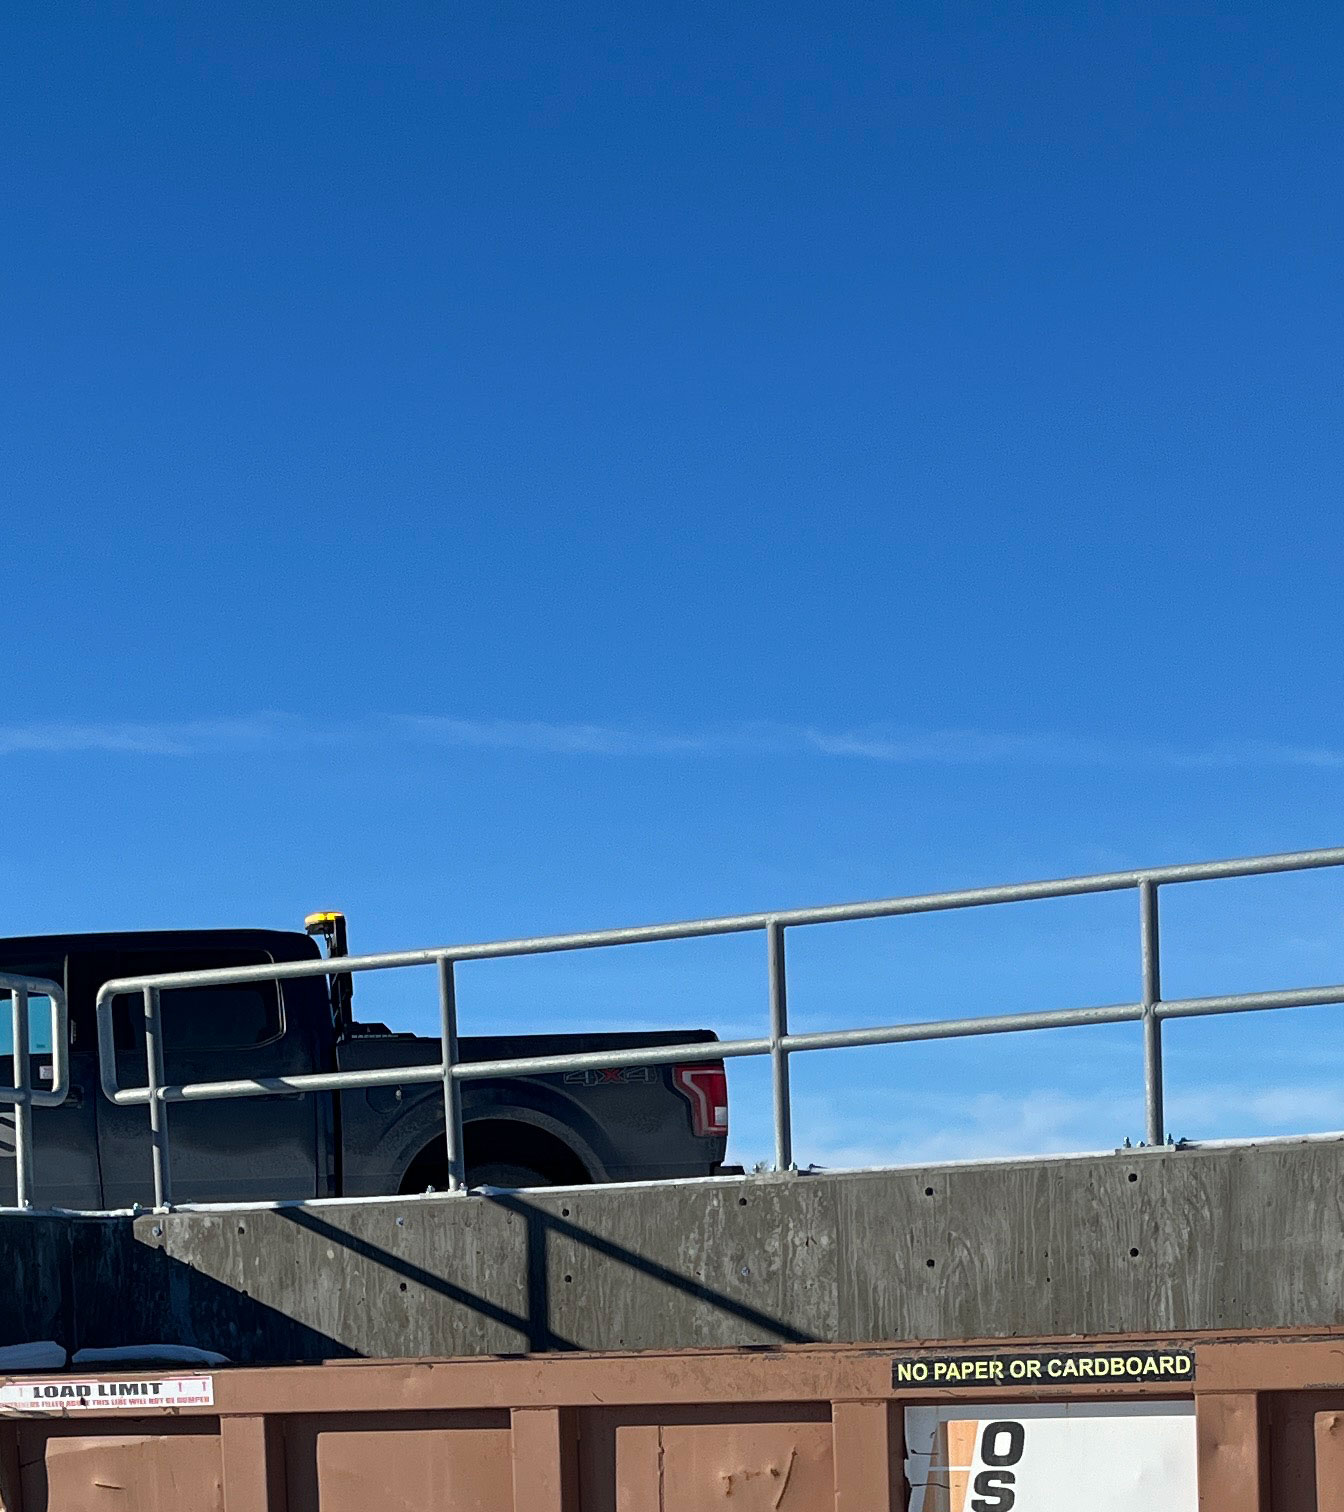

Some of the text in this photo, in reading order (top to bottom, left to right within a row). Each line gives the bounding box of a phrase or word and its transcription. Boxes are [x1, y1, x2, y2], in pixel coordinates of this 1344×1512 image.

[897, 1355, 1191, 1381] NO PAPER OR CARDBOARD
[33, 1382, 163, 1399] LOAD LIMIT
